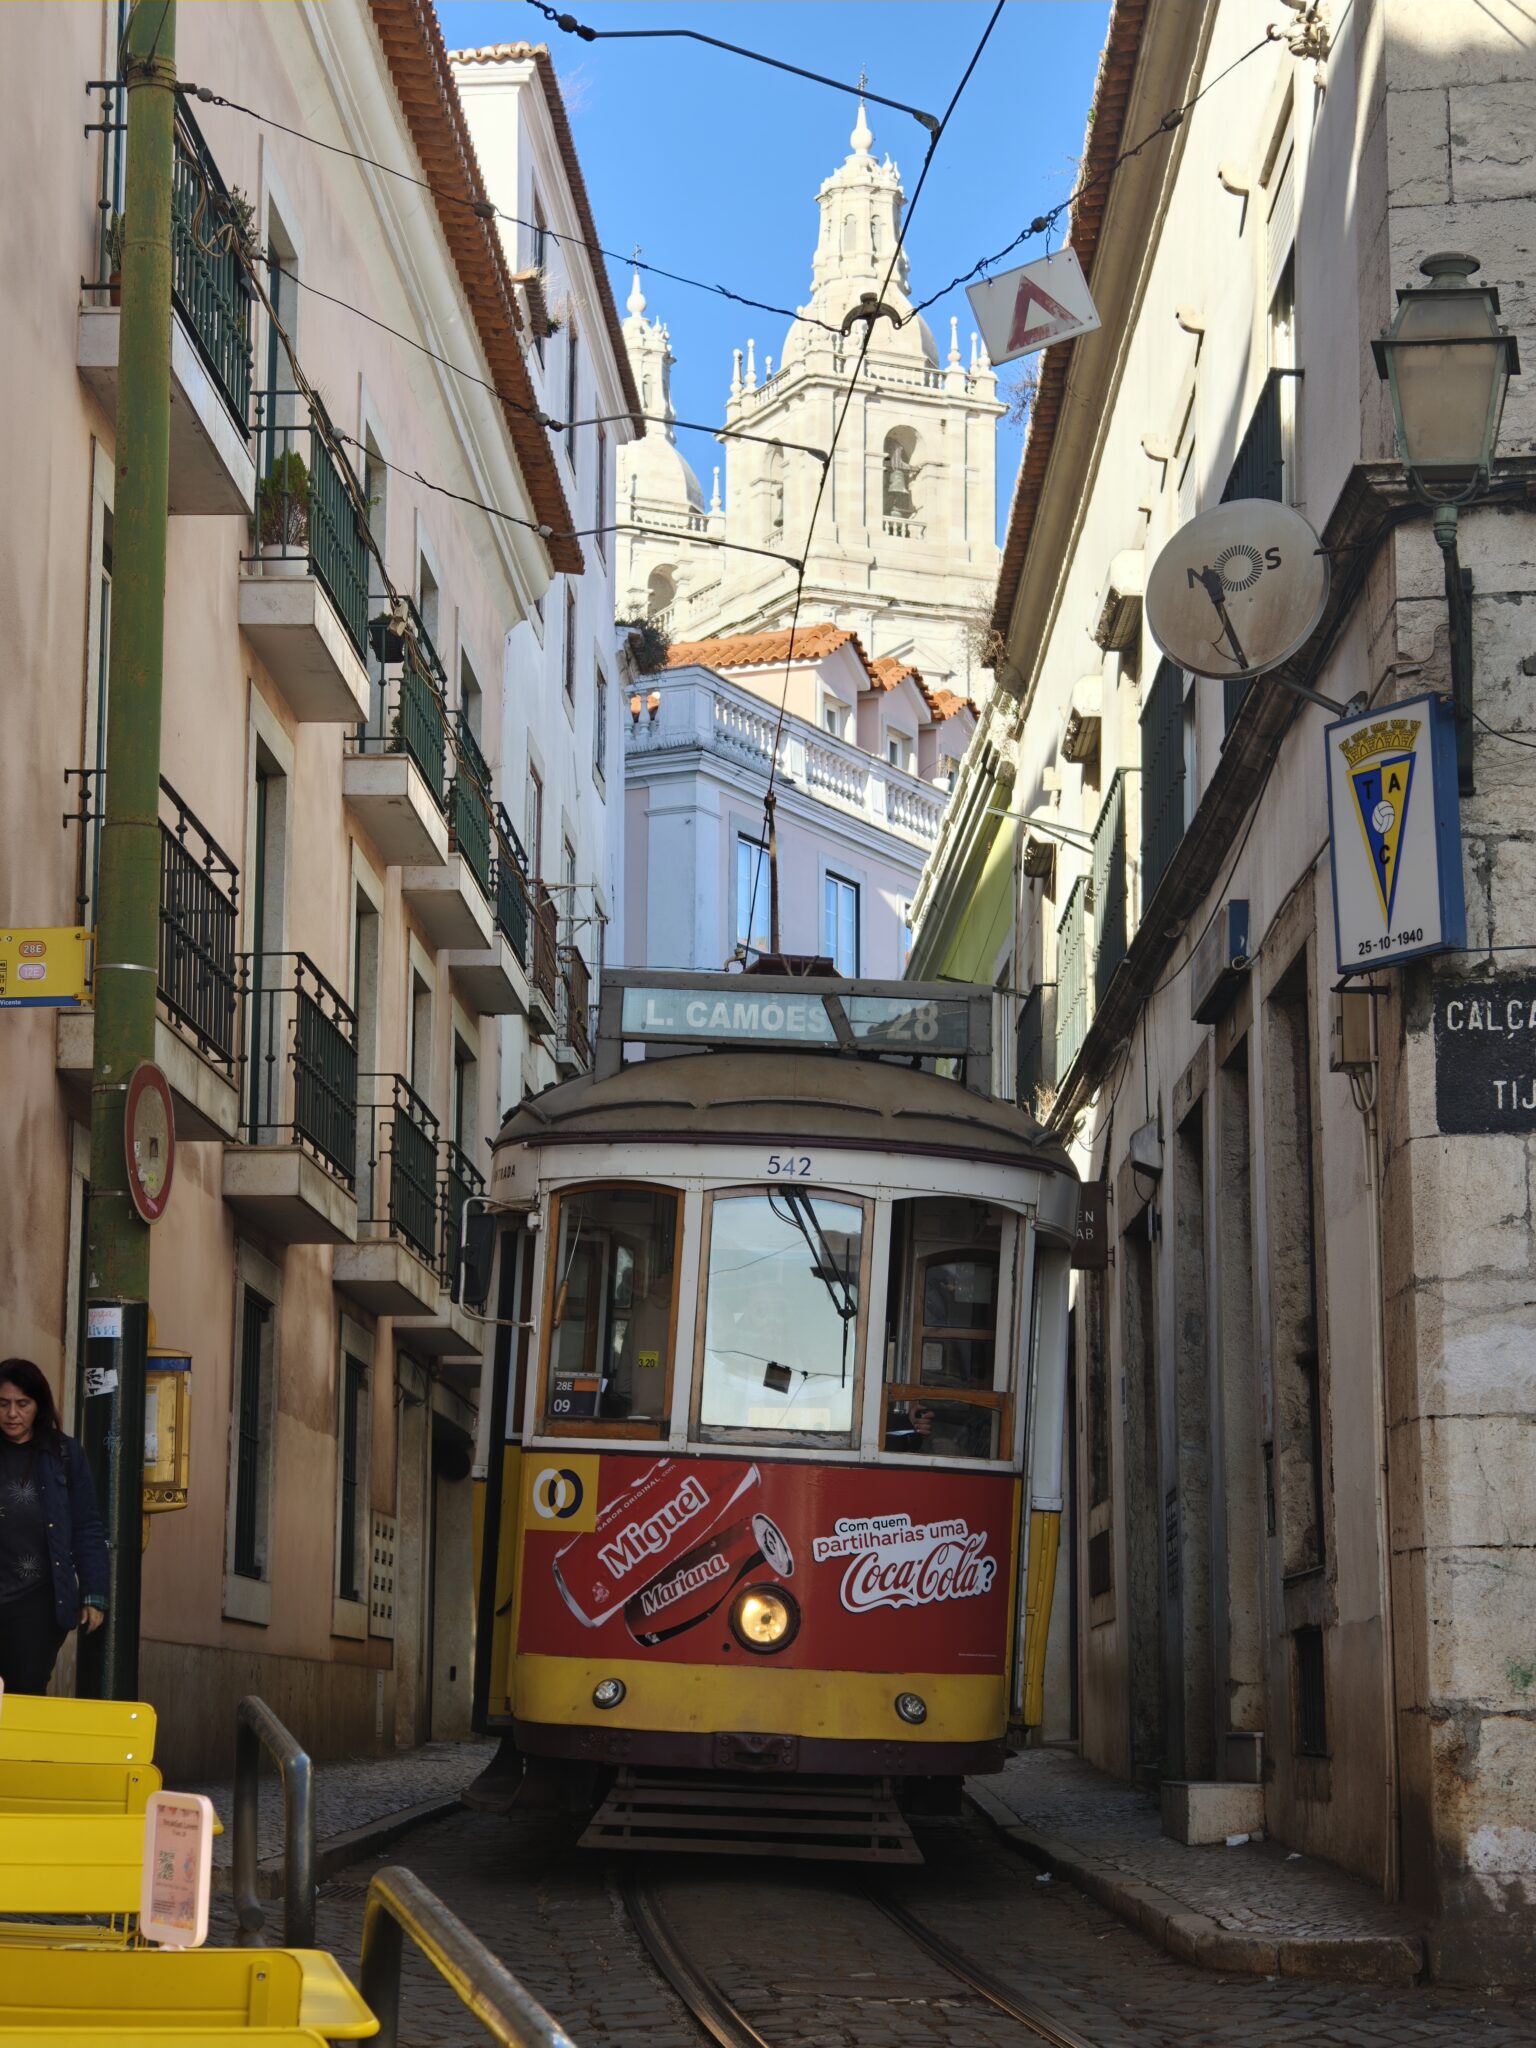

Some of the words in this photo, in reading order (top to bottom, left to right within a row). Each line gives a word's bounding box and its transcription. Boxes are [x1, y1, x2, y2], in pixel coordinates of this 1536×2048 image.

[23, 944, 42, 953] 28E
[1358, 928, 1424, 956] 25-10-1940
[24, 967, 40, 976] 12E
[645, 998, 675, 1027] L.
[887, 1000, 940, 1042] 28
[767, 1155, 812, 1177] 542
[555, 1381, 573, 1391] 28E
[553, 1399, 571, 1413] 09
[596, 1508, 623, 1532] SABOR
[623, 1477, 661, 1509] ORIGINAL
[597, 1475, 710, 1579] Miguel
[838, 1521, 869, 1533] Com
[872, 1516, 908, 1534] quem
[816, 1528, 925, 1557] partilharias
[929, 1522, 966, 1539] uma
[641, 1554, 729, 1616] Mariana
